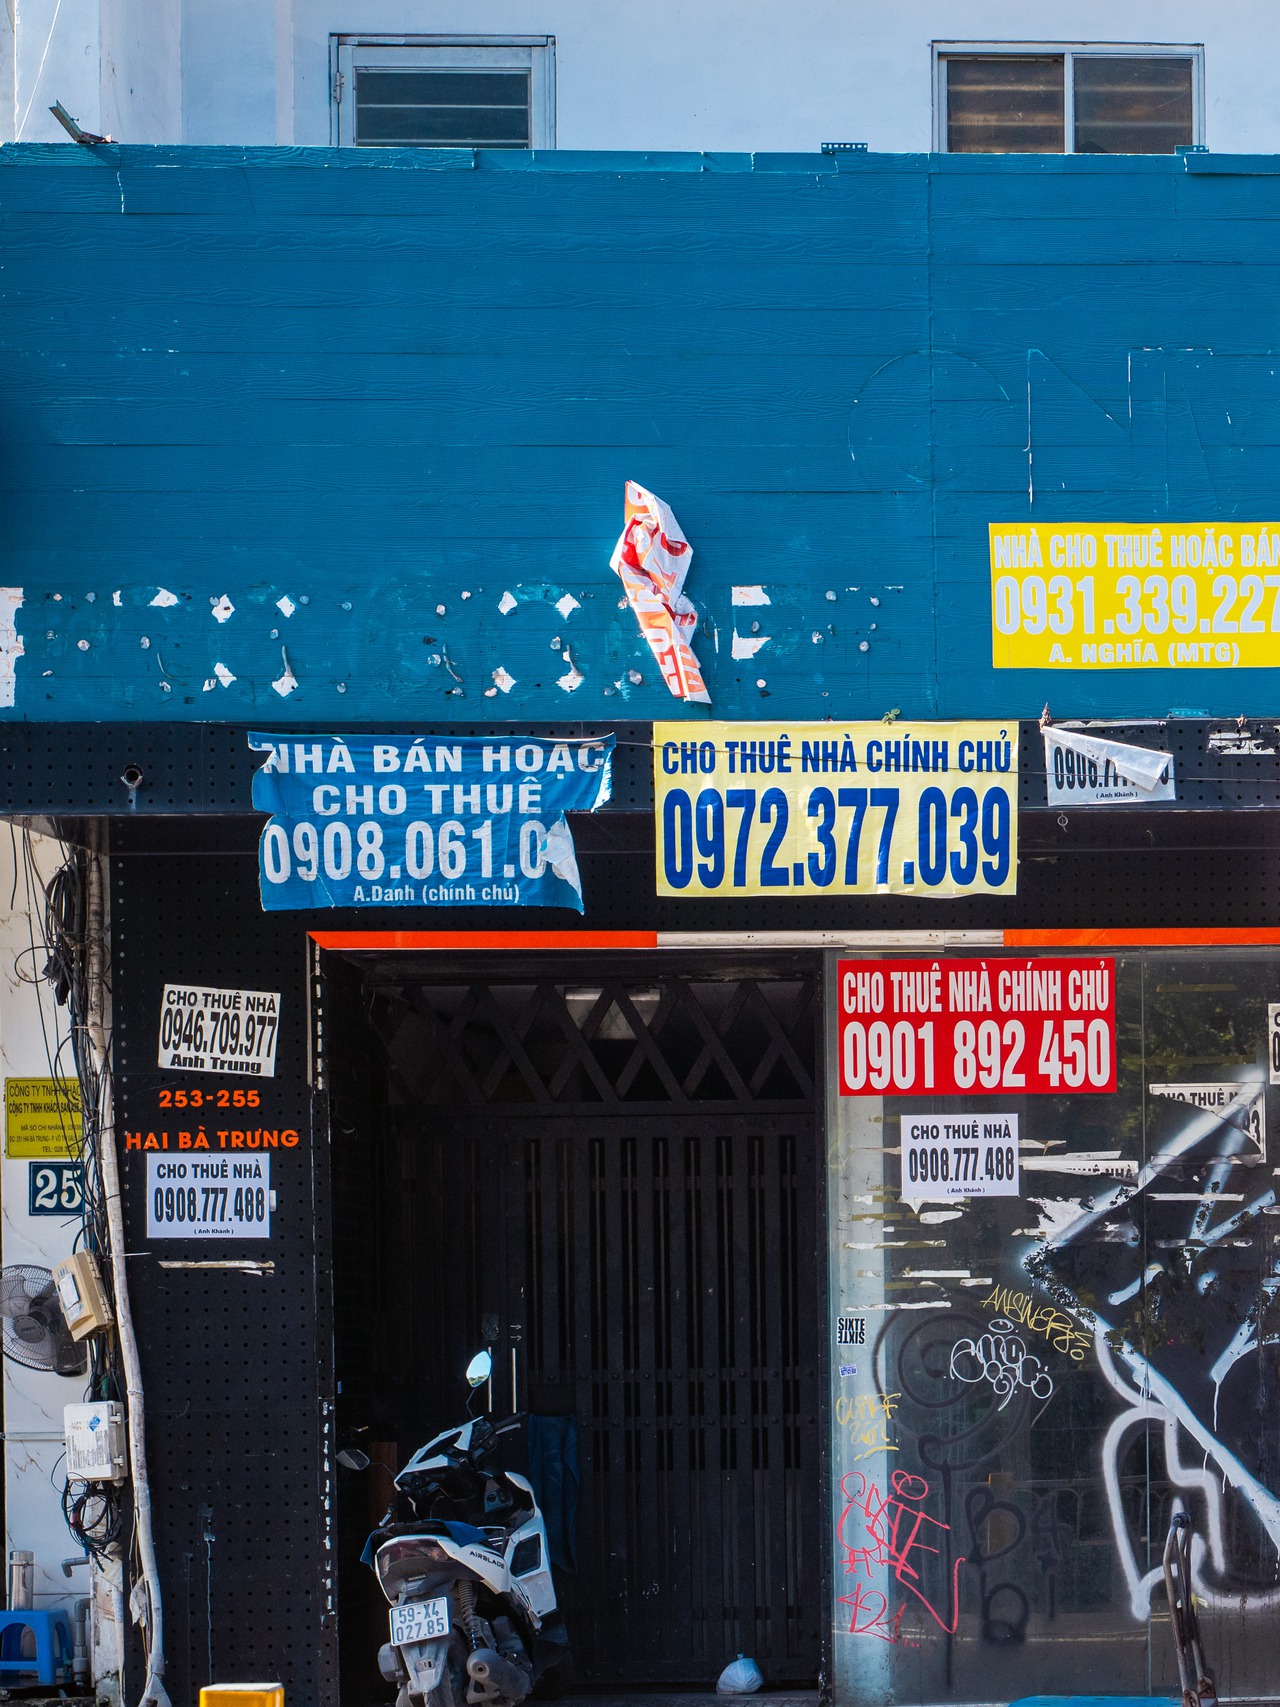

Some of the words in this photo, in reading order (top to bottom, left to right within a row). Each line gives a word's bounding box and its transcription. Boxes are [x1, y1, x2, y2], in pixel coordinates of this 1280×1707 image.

[994, 529, 1043, 568] NHÀ
[1050, 535, 1096, 568] CHO
[1104, 528, 1162, 567] THUÊ
[1171, 528, 1233, 574] HOẶC
[1049, 643, 1072, 662] A.
[1082, 639, 1159, 663] NGHĨA
[1168, 642, 1240, 665] (MTG)
[262, 737, 355, 773] NHÀ
[373, 738, 462, 773] BÁN
[662, 741, 716, 774] CHO
[725, 734, 792, 773] THUÊ
[802, 734, 857, 773] NHÀ
[867, 734, 948, 772] CHÍNH
[958, 729, 1011, 773] CHỦ
[312, 785, 407, 815] CHO
[424, 776, 542, 814] THUÊ
[663, 786, 1010, 889] 0972.377.039
[263, 820, 566, 883] 0908.061.0
[353, 885, 415, 902] A.Danh
[422, 884, 474, 903] (chính
[482, 883, 520, 903] chủ)
[843, 972, 884, 1014] CHO
[891, 963, 942, 1013] THUÊ
[949, 962, 992, 1012] NHÀ
[998, 962, 1061, 1012] CHÍNH
[1068, 961, 1109, 1011] CHỦ
[166, 990, 197, 1006] CHO
[202, 992, 242, 1010] THUÊ
[245, 995, 276, 1013] NHÀ
[162, 1007, 277, 1058] 0946.709.977
[170, 1054, 205, 1068] Anh
[210, 1057, 261, 1074] Trung
[844, 1021, 934, 1090] 0901
[954, 1019, 1025, 1088] 892
[1038, 1018, 1110, 1087] 450
[9, 1084, 30, 1097] CÔNG
[32, 1086, 40, 1097] TY
[159, 1090, 260, 1107] 253-255
[1190, 1088, 1224, 1106] THUÊ
[24, 1103, 29, 1113] TY
[126, 1132, 168, 1149] HAI
[178, 1126, 210, 1149] BÀ
[217, 1129, 299, 1148] TRƯNG
[911, 1125, 939, 1140] CHO
[944, 1120, 979, 1139] THUÊ
[984, 1120, 1011, 1138] NHÀ
[157, 1164, 187, 1179] CHO
[192, 1159, 228, 1178] THUÊ
[233, 1159, 262, 1178] NHÀ
[909, 1147, 1014, 1182] 0908.777.488
[154, 1187, 265, 1222] 0908.777.488
[838, 1318, 865, 1331] SIXTE
[399, 1602, 439, 1624] 59-X4
[397, 1617, 444, 1641] 027.85
